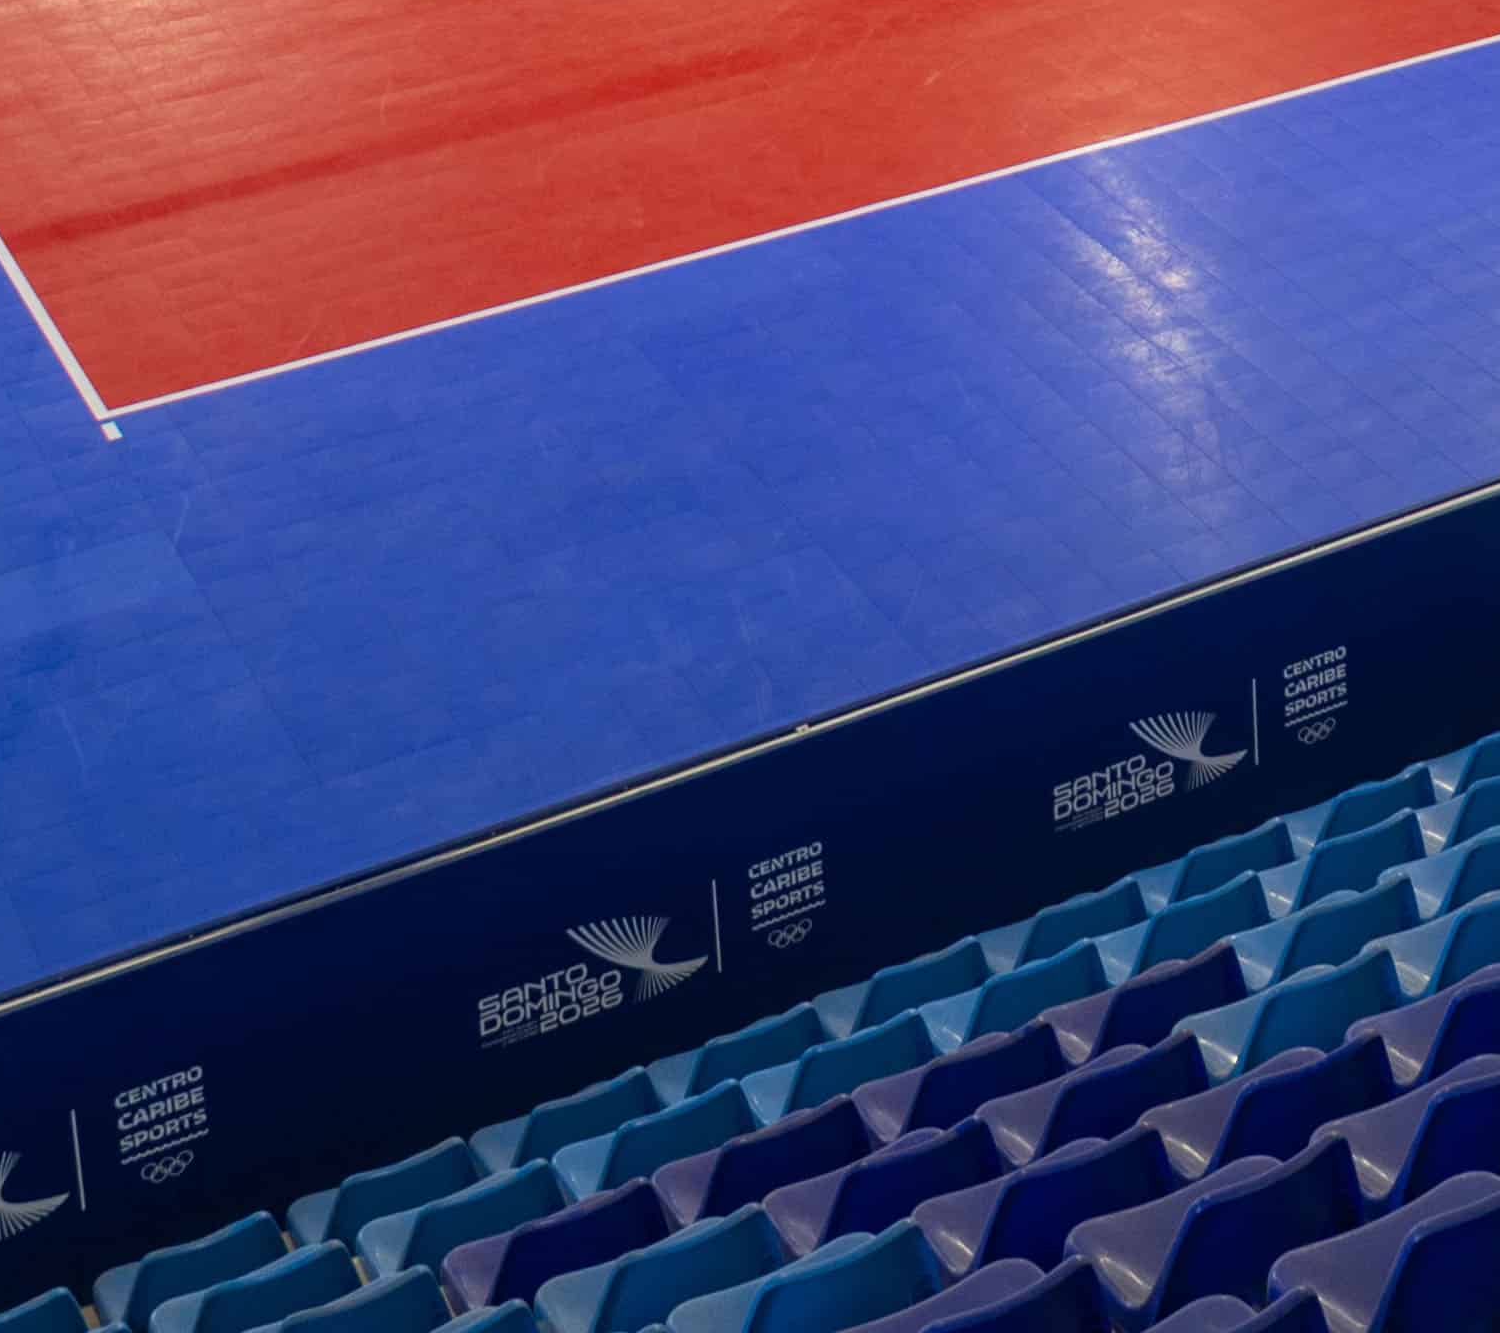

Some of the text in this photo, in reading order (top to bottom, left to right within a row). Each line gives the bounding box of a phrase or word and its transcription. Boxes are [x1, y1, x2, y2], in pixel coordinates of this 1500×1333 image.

[1283, 645, 1347, 680] CENTRO
[1284, 662, 1348, 699] CARIBE
[1285, 682, 1348, 717] SPORTS
[1053, 754, 1146, 802] SANTO
[1054, 761, 1174, 821] DOMINGO
[1104, 777, 1175, 818] 2026
[748, 841, 822, 880] CENTRO
[750, 859, 823, 900] CARIBE
[751, 881, 825, 920] SPORTS
[478, 962, 588, 1017] SANTO
[480, 969, 622, 1037] DOMINGO
[540, 987, 624, 1033] 2026
[115, 1065, 203, 1109] CENTRO
[117, 1085, 205, 1131] CARIBE
[120, 1109, 207, 1152] SPORTS
